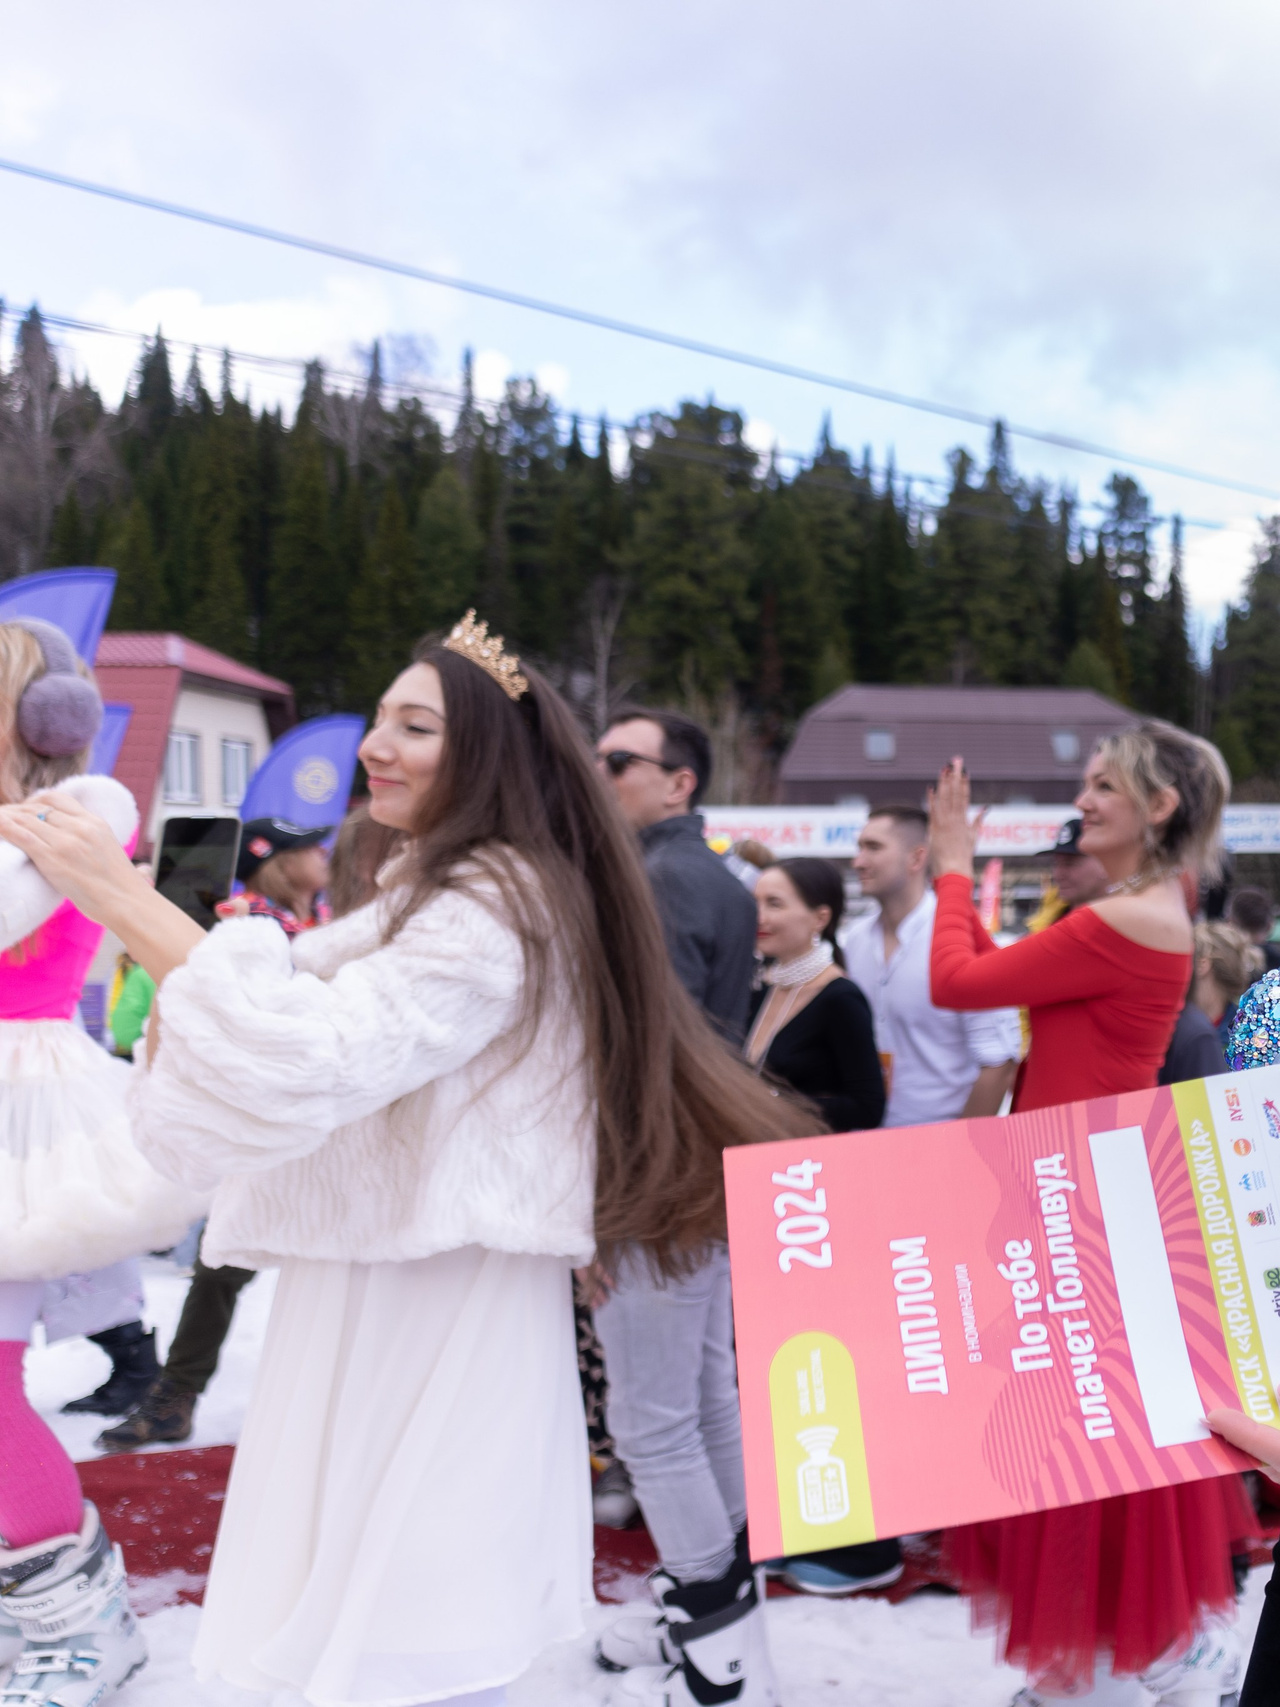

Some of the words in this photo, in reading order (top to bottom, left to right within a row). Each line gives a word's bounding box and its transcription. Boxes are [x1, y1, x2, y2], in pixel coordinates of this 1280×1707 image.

[771, 1158, 833, 1274] 2024
[1033, 1153, 1087, 1314] Голливуд
[1189, 1119, 1234, 1238] ДОРОЖКА»
[889, 1235, 949, 1396] ДИПЛОМ
[997, 1238, 1043, 1320] тебе
[1210, 1239, 1253, 1354] «КРАСНАЯ
[1011, 1322, 1054, 1373] По
[1062, 1317, 1116, 1440] плачет
[1236, 1354, 1276, 1424] СПУСК
